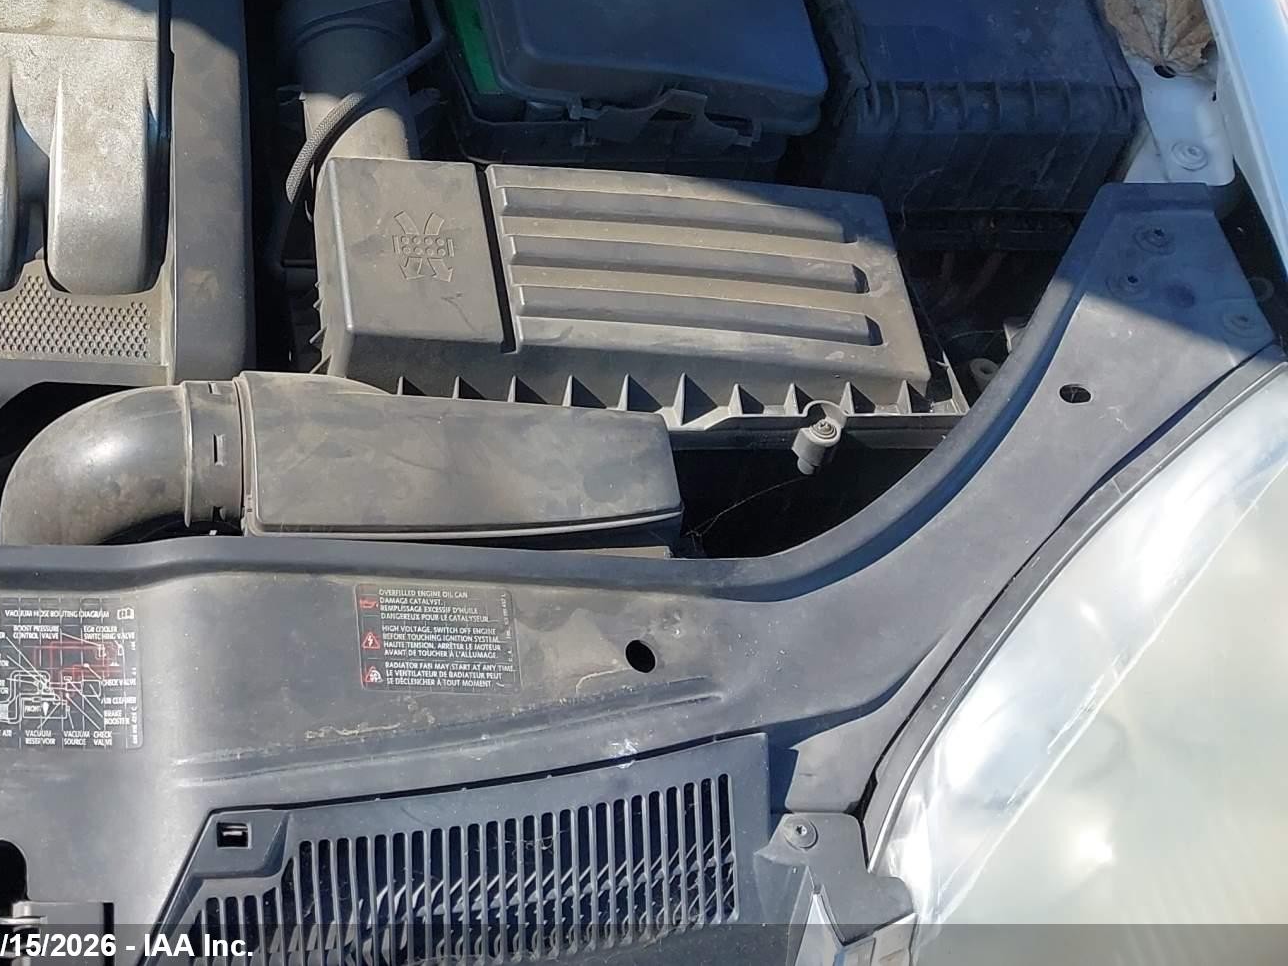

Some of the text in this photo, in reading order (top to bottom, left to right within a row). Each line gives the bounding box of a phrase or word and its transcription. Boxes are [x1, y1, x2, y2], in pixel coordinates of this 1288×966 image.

[442, 590, 454, 598] OIL
[4, 609, 33, 617] VACUUM
[50, 609, 78, 618] ROUTING
[78, 610, 110, 618] DIAGRAM
[13, 632, 59, 640] CONTROL VALVE
[83, 632, 136, 640] SWITCHING VALVE
[408, 649, 417, 657] DE
[385, 661, 418, 669] RADIATOR
[394, 669, 437, 677] VENTILATEUR
[439, 670, 448, 678] DE
[448, 671, 485, 679] RADIATEUR
[112, 696, 137, 704] CLEANER
